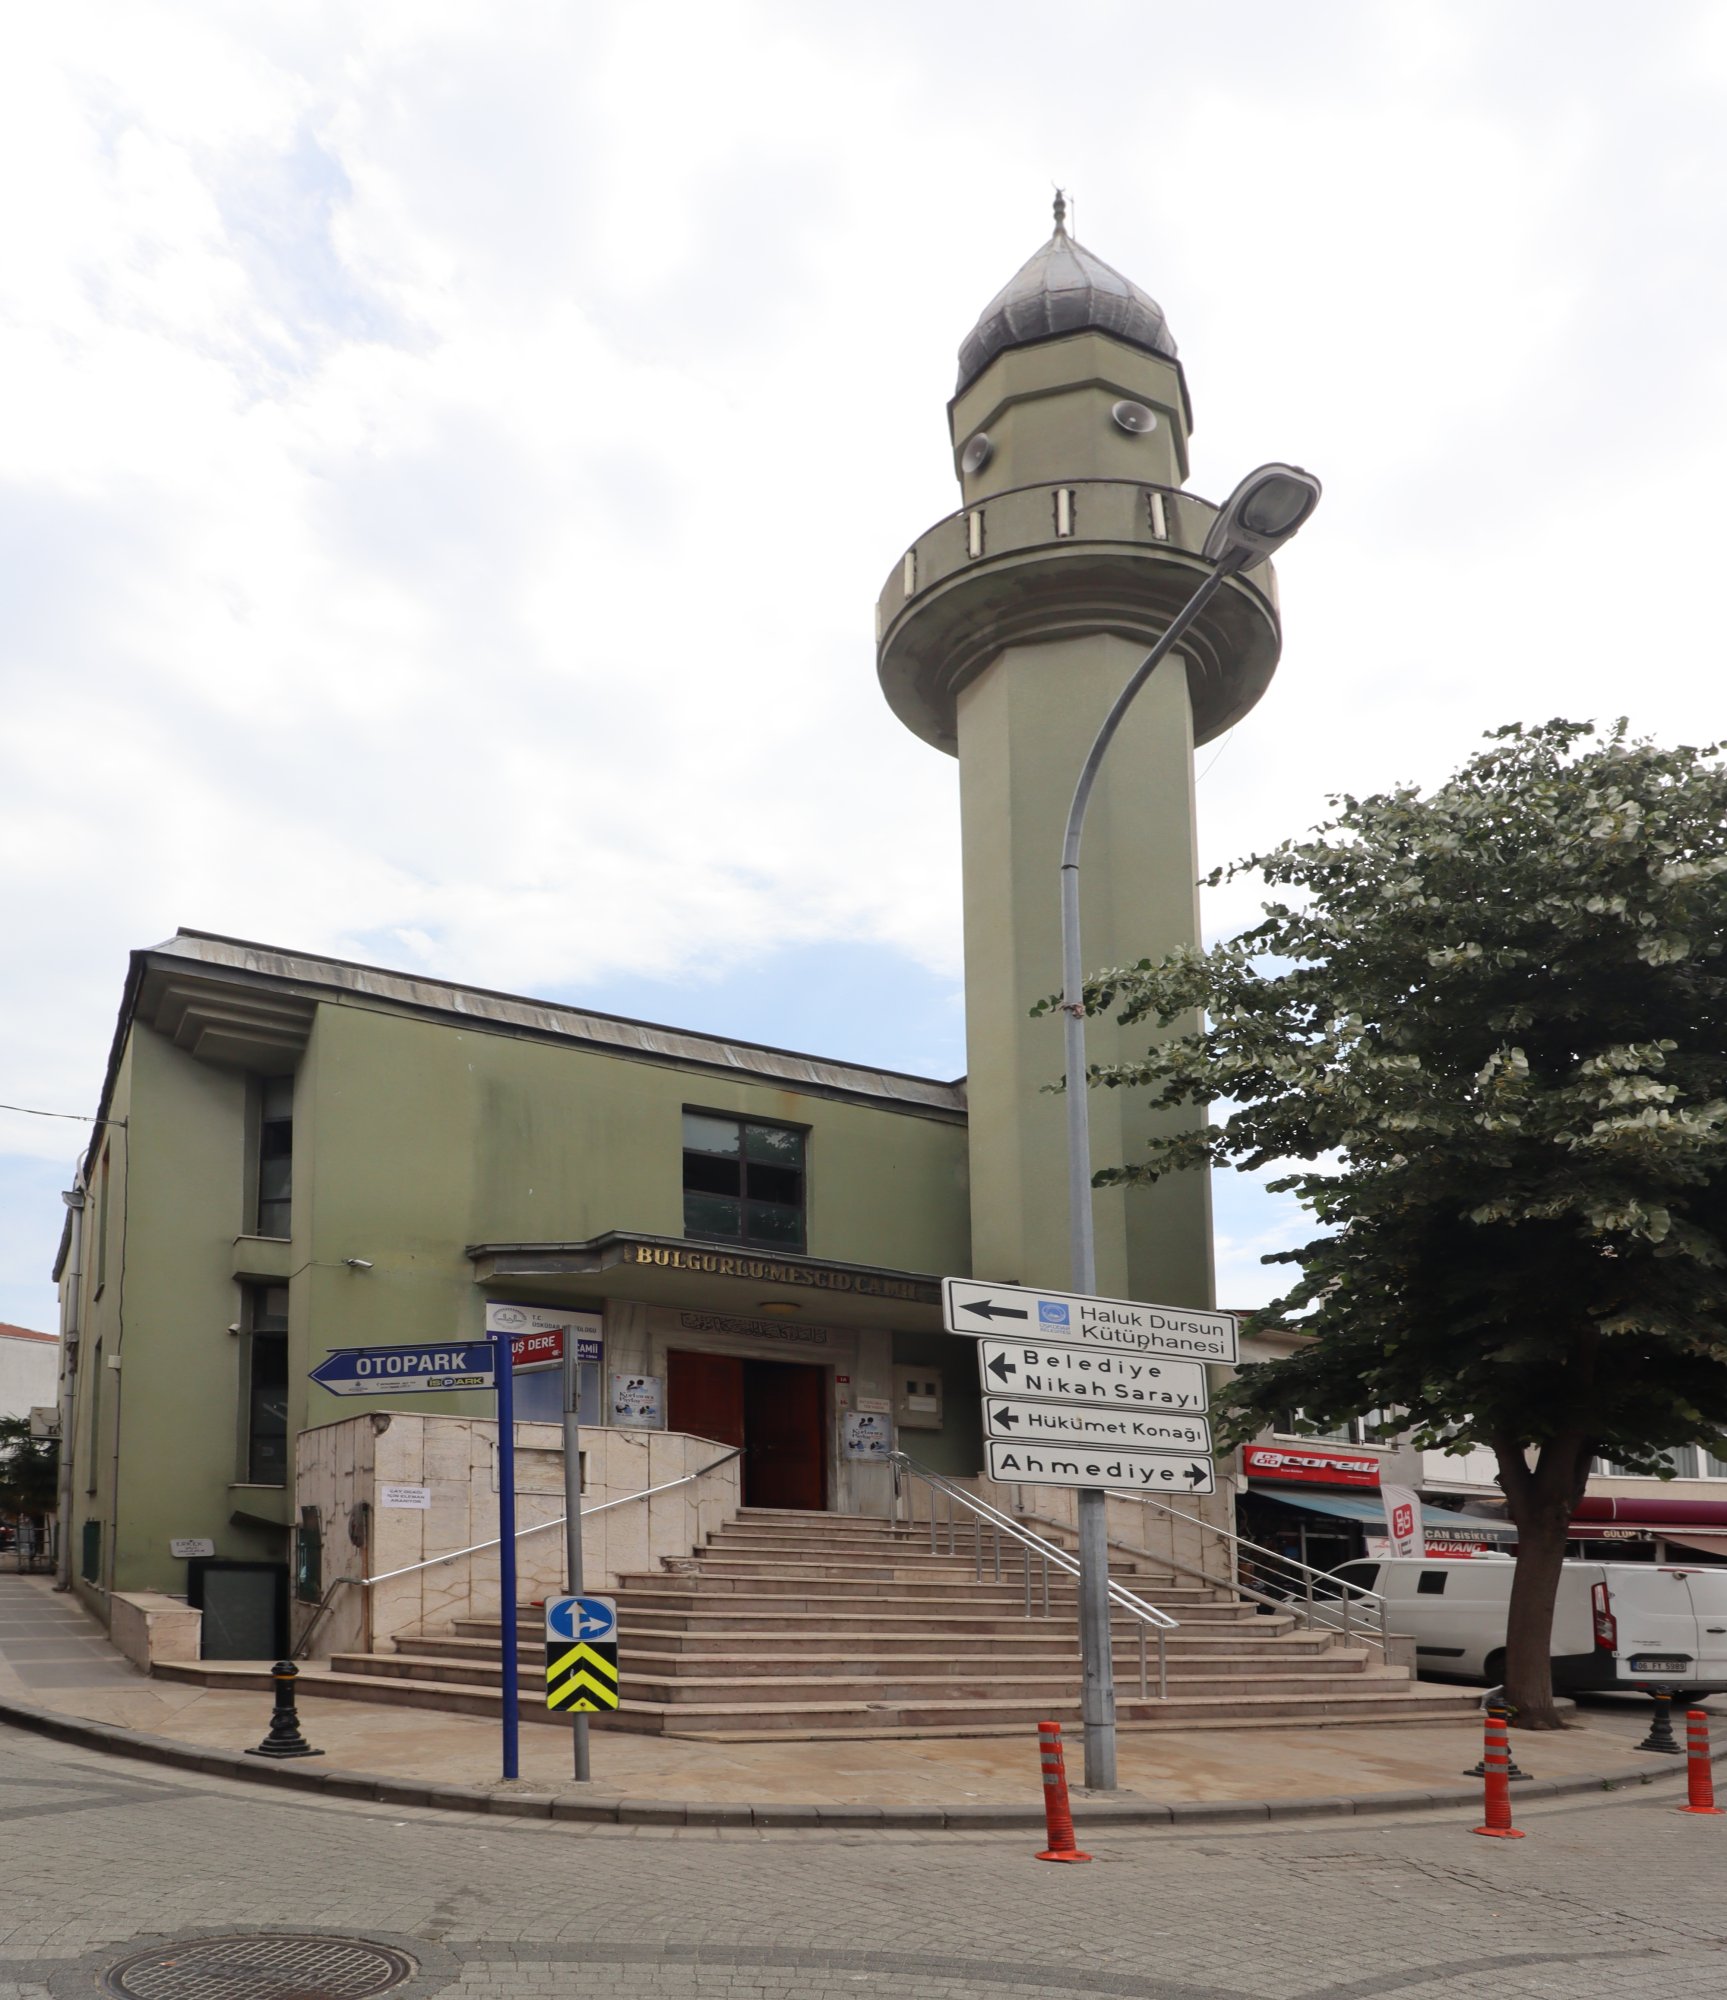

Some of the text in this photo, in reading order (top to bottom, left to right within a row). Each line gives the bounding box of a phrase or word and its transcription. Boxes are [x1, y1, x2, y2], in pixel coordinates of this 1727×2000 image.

[635, 1246, 766, 1279] BULGURLU
[1080, 1305, 1224, 1337] Haluk Dursun
[527, 1335, 556, 1351] DERE
[1082, 1324, 1225, 1354] Kütüphanesi
[356, 1352, 467, 1376] OTOPARK
[1024, 1350, 1162, 1379] Belediye
[1025, 1375, 1198, 1408] Nikah Sarayı
[1028, 1413, 1201, 1443] Hükümet Konağı
[1000, 1453, 1175, 1484] Ahmediye
[1281, 1455, 1380, 1473] corelli
[1424, 1540, 1482, 1553] HAOYANG
